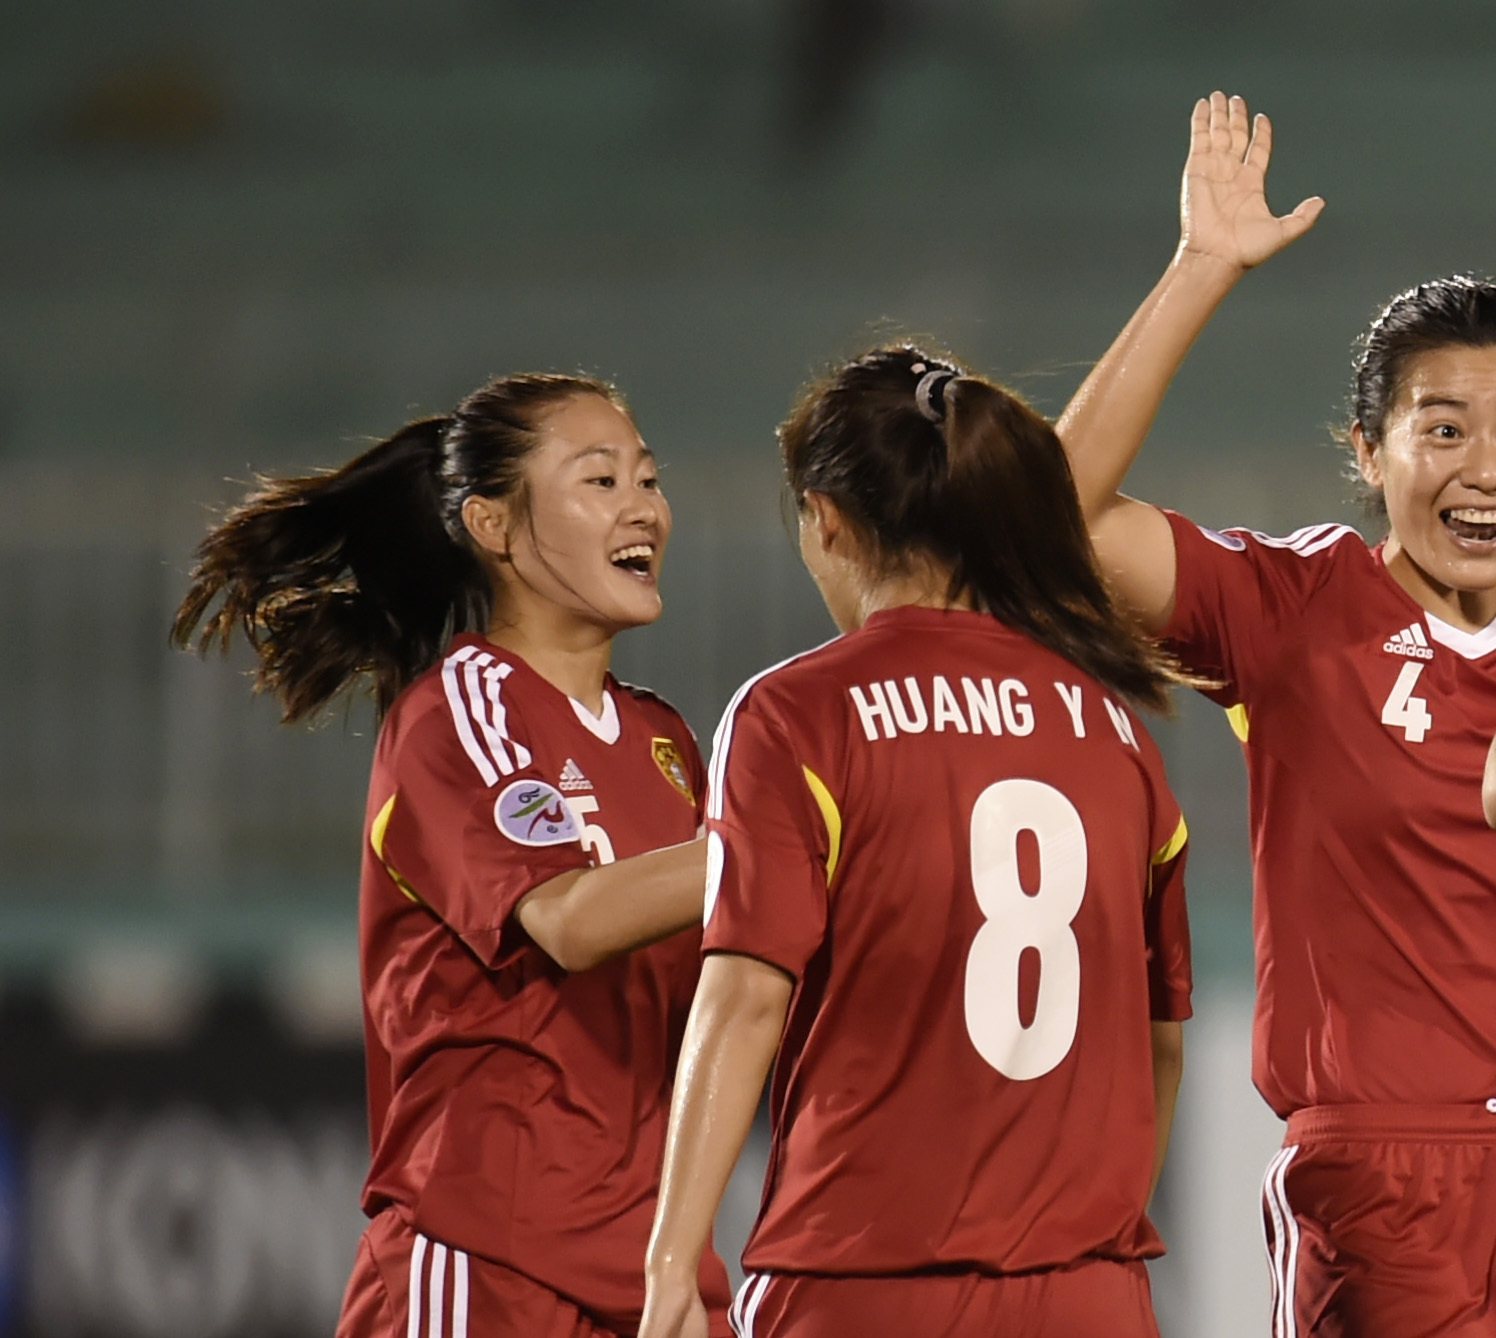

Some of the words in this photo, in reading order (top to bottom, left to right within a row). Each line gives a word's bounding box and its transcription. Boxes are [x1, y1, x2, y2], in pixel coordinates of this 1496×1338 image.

[1382, 641, 1434, 660] adidas
[849, 675, 1035, 741] HUANG
[1054, 681, 1086, 738] Y
[1381, 661, 1432, 743] 4
[964, 779, 1088, 1081] 8
